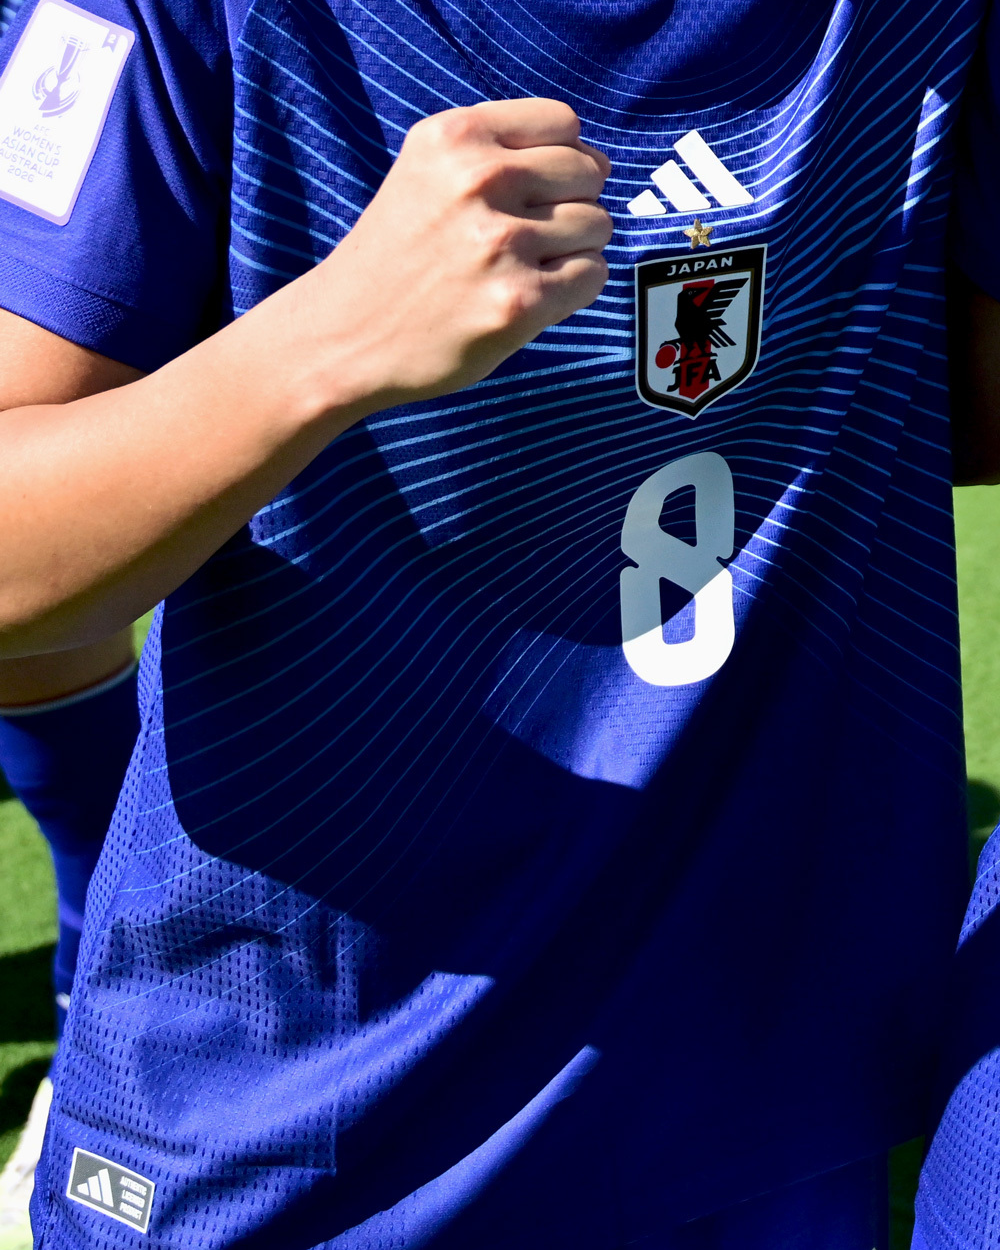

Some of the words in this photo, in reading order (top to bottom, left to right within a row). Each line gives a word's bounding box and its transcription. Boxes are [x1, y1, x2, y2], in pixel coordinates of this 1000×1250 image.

[1, 136, 37, 159] ASIAN
[37, 151, 60, 168] CUP
[12, 125, 62, 156] WOMEN'S
[7, 164, 35, 183] 2026
[667, 256, 733, 276] JAPAN
[666, 358, 722, 393] JFA
[620, 451, 735, 687] 8
